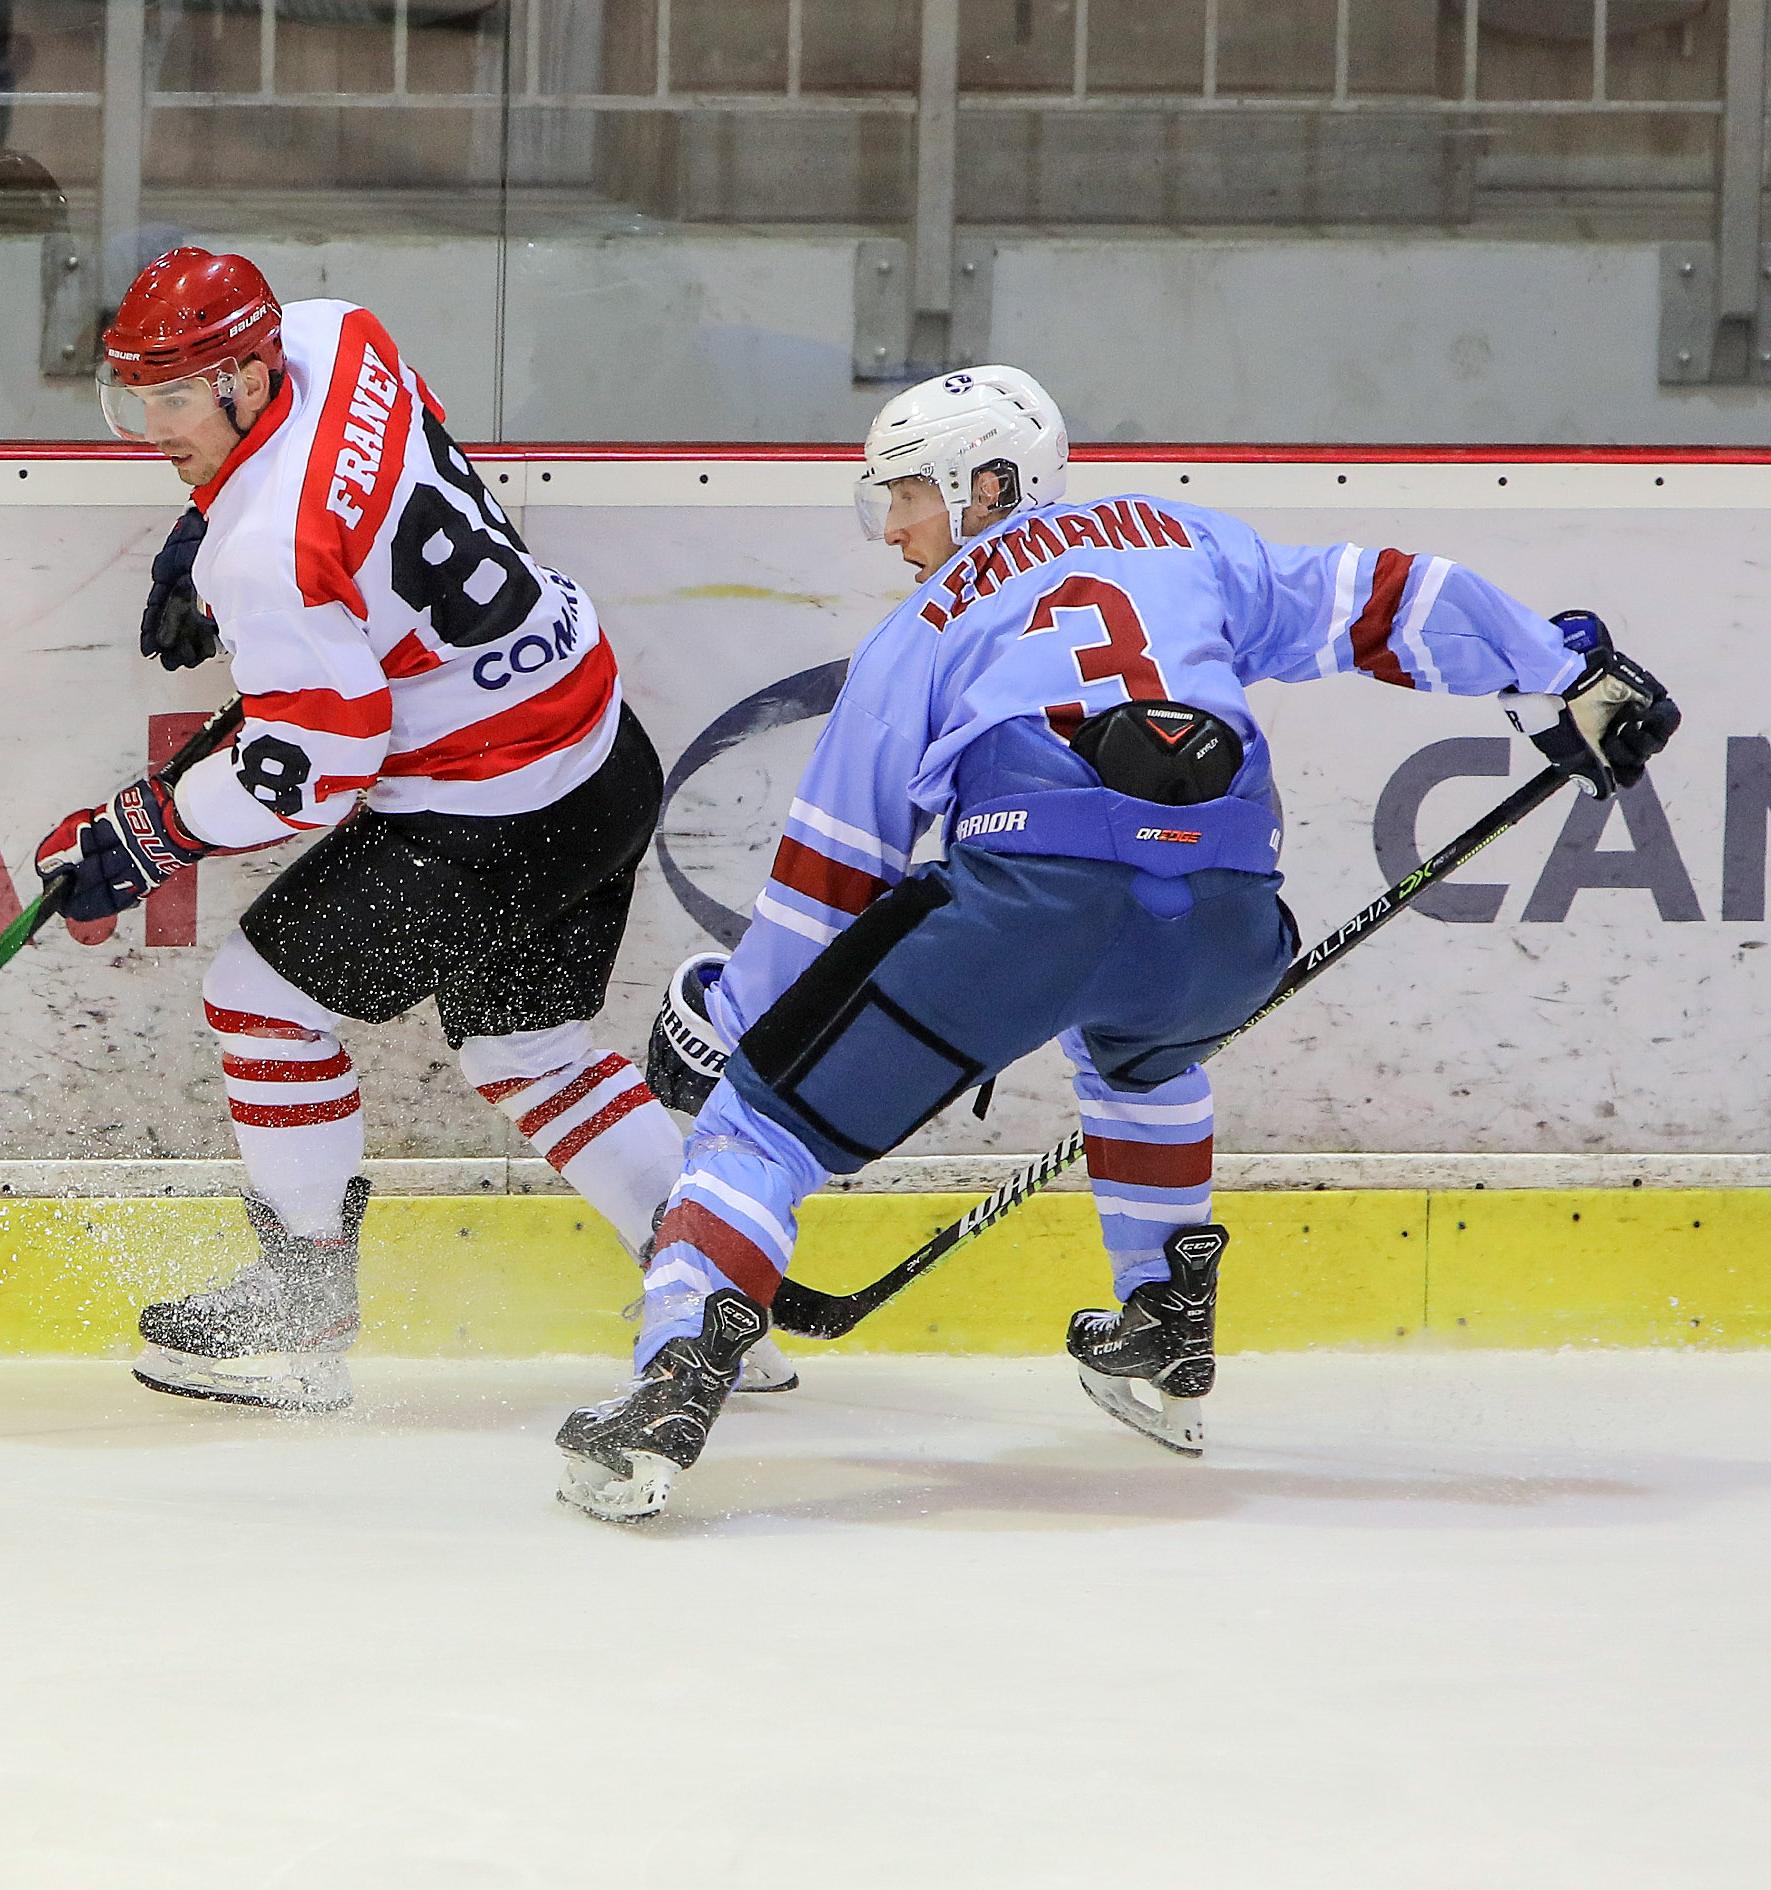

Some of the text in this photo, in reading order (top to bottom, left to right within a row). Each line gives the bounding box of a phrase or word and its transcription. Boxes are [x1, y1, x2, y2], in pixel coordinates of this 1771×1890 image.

[108, 348, 141, 361] BAUER
[228, 305, 268, 338] BAUER
[328, 343, 399, 529] FRANEY
[917, 499, 1193, 633] LEHMANN
[1018, 571, 1171, 747] 3
[119, 786, 191, 876] BAUE
[1373, 736, 1771, 923] CA
[1306, 896, 1392, 971] ALPHA
[958, 1127, 1085, 1239] WARR
[1182, 1240, 1217, 1251] CCM
[723, 1306, 754, 1327] CCM
